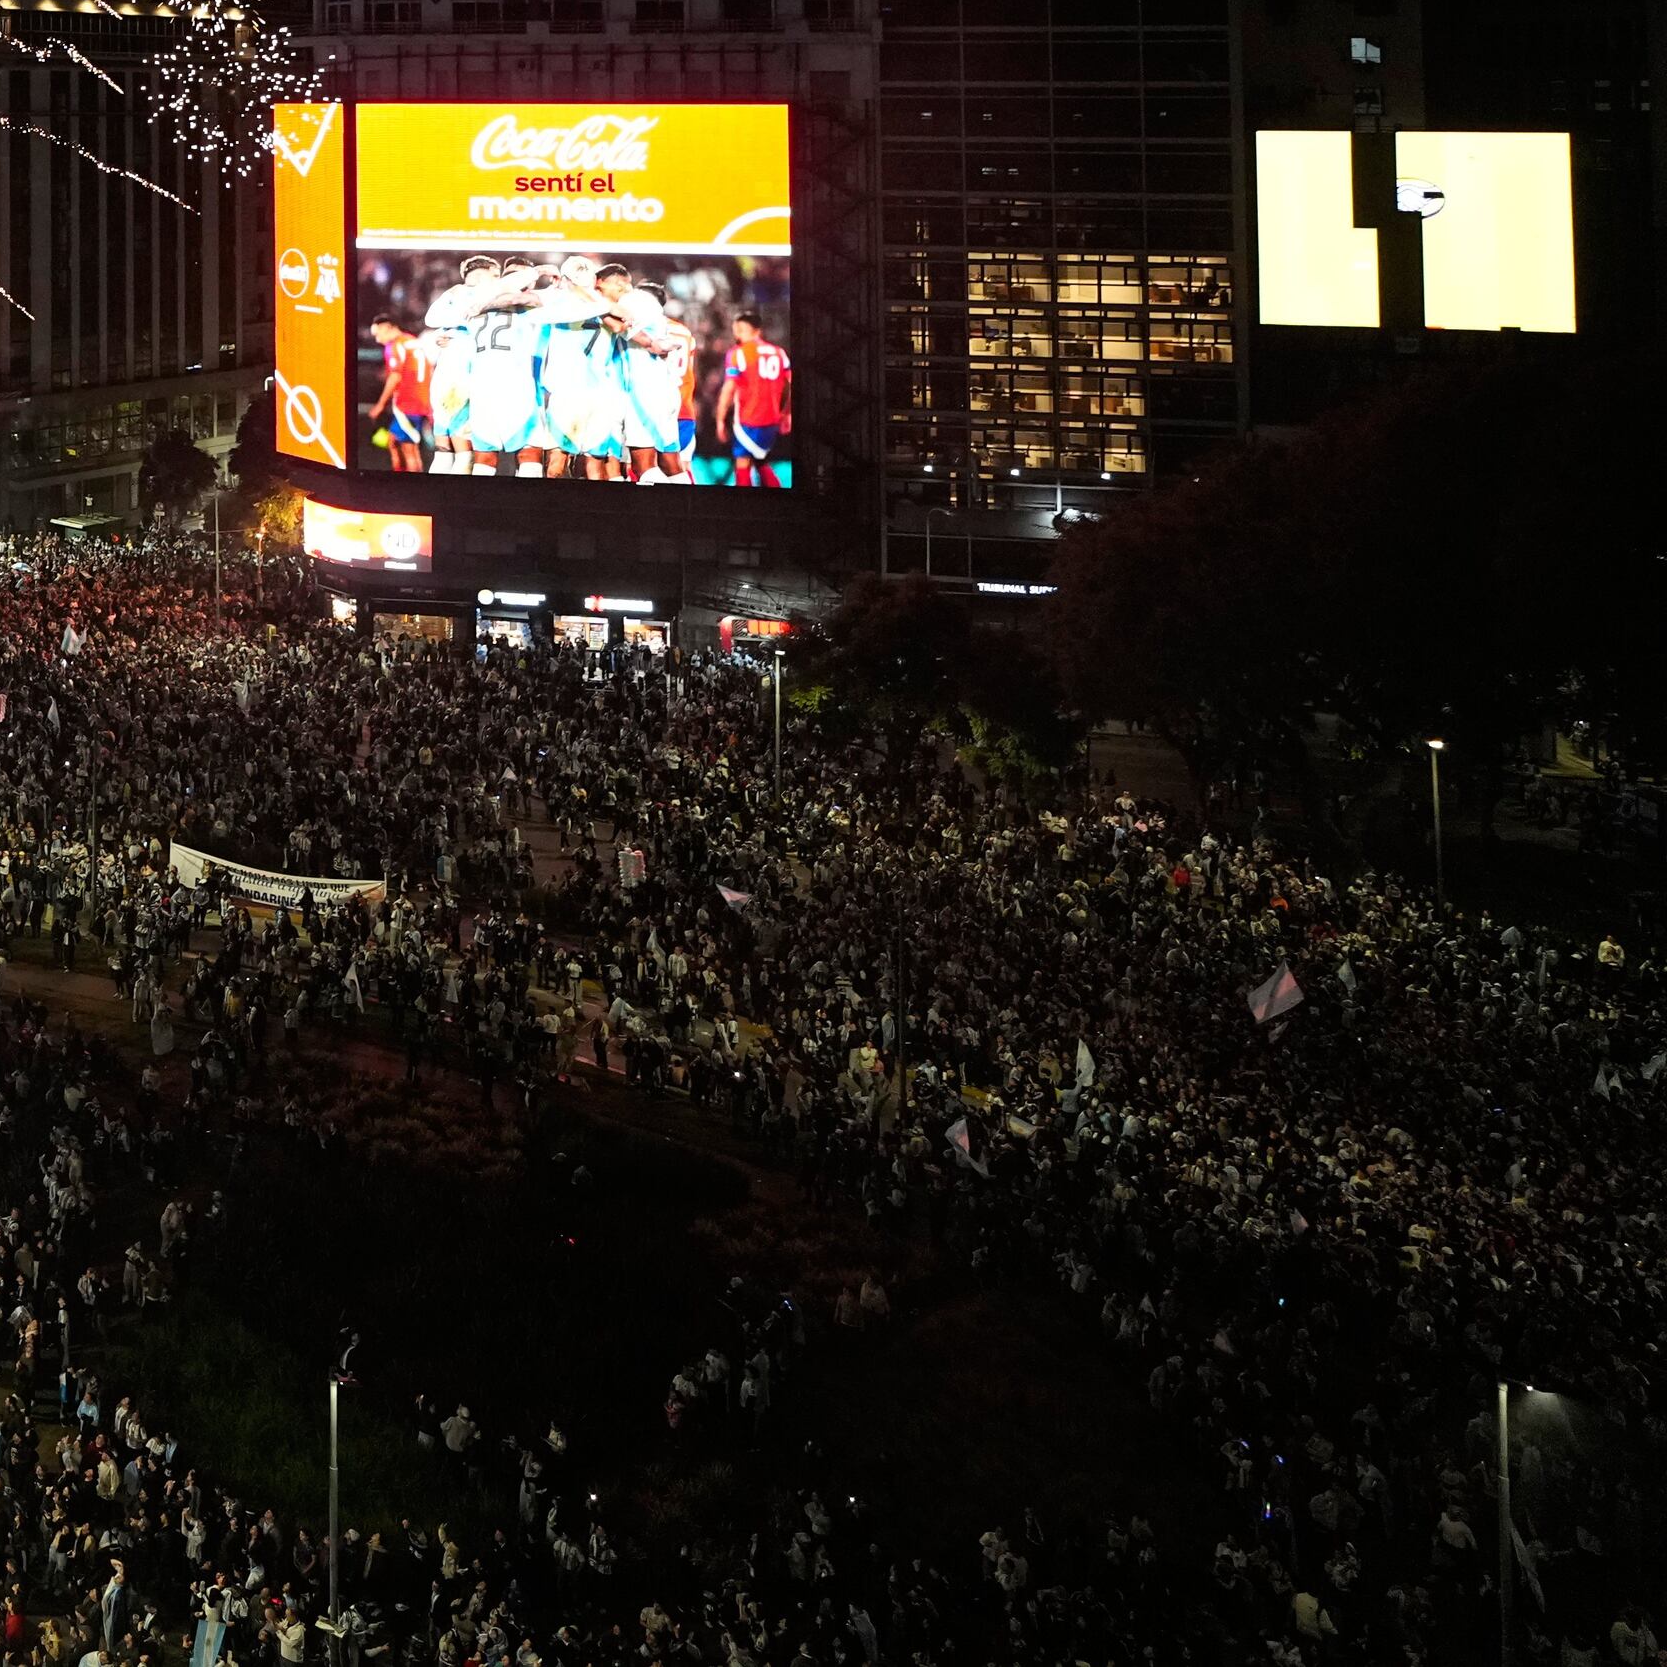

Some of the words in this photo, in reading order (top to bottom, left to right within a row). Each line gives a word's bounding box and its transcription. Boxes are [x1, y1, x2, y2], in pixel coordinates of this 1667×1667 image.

[514, 172, 582, 193] sentí
[589, 173, 615, 193] el
[469, 193, 664, 222] momento
[330, 883, 352, 893] QUE
